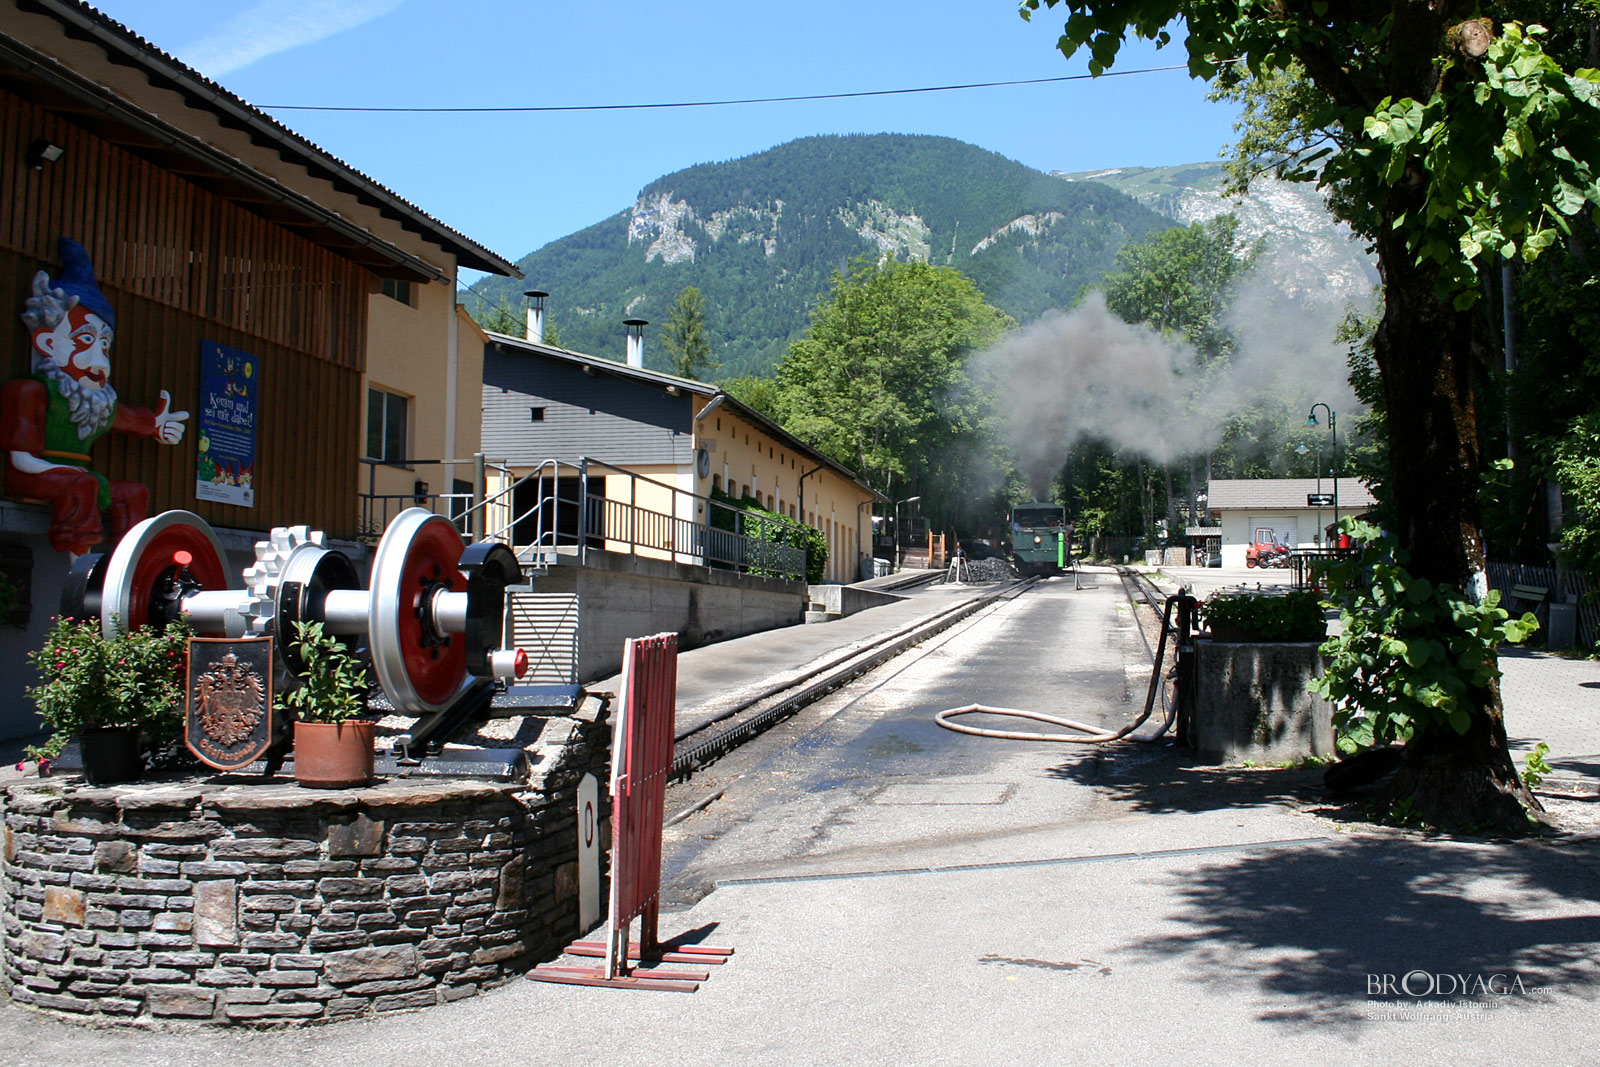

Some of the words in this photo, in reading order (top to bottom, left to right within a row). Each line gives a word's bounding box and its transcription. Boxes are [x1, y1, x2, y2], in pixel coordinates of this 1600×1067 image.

[209, 393, 234, 409] Komm
[236, 400, 249, 414] und
[204, 407, 216, 418] sei
[217, 408, 230, 422] mit
[231, 410, 253, 428] dabei!
